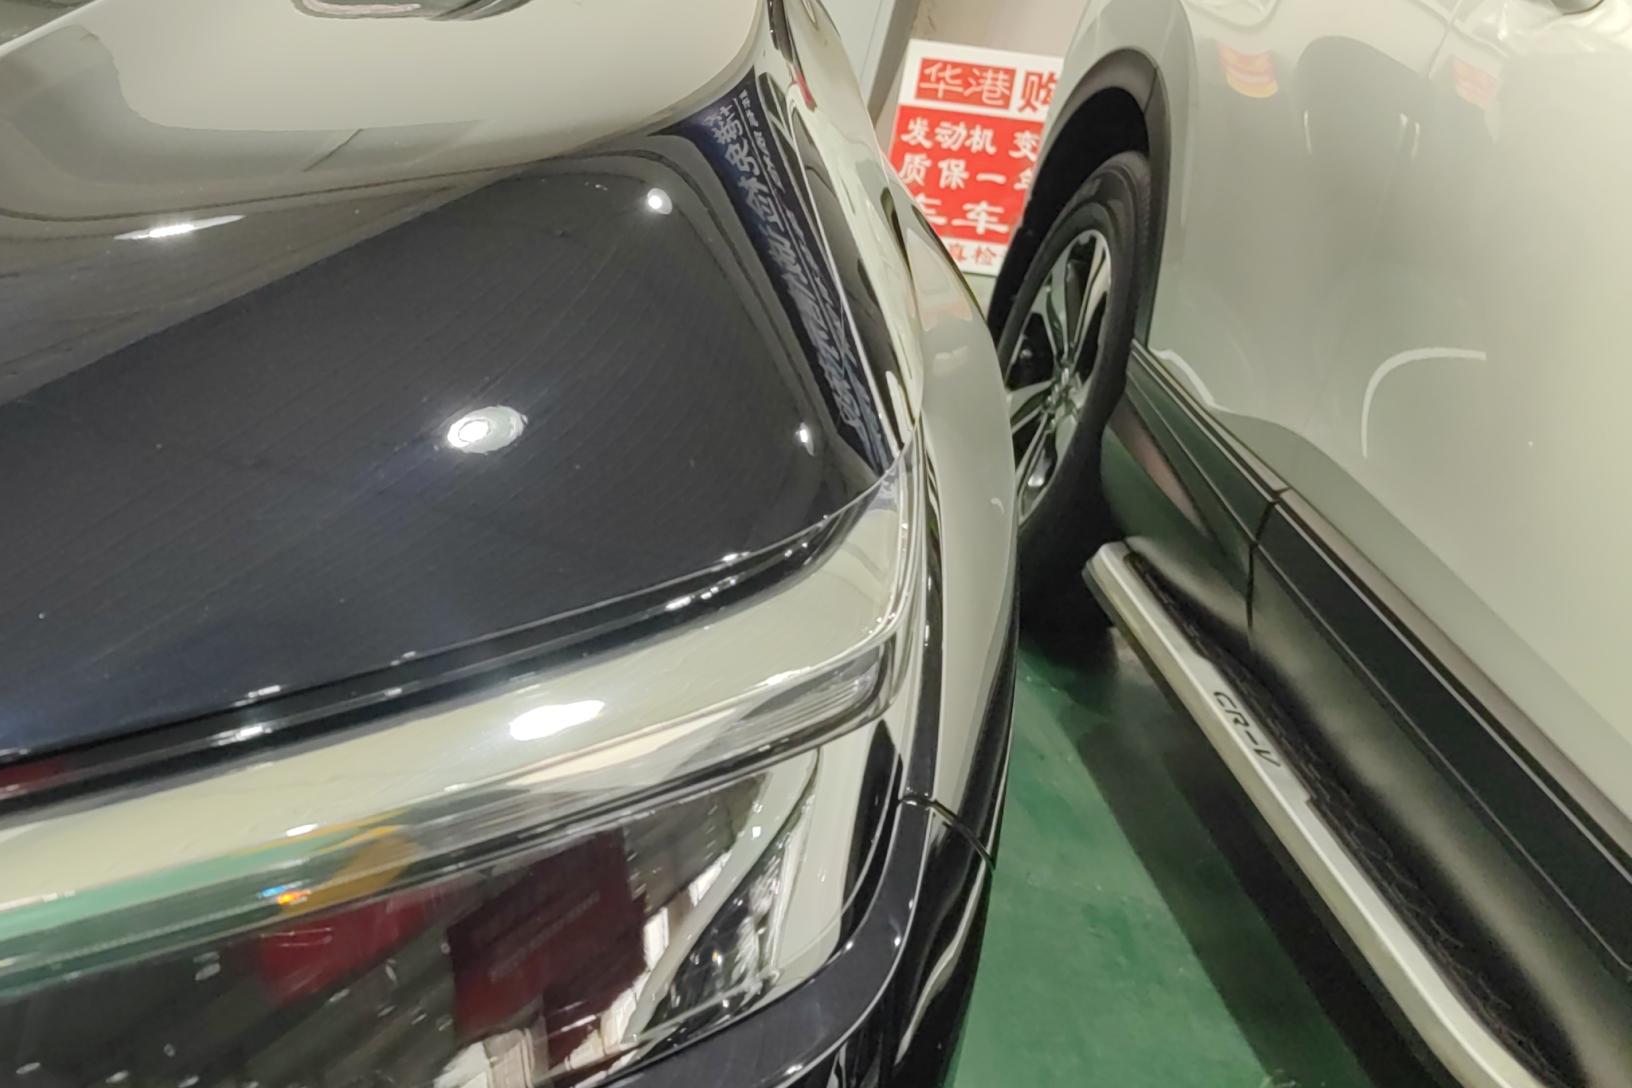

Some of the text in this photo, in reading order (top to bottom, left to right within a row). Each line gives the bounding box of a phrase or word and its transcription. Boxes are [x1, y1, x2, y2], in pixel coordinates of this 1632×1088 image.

[919, 61, 1011, 106] 华港
[900, 116, 997, 154] 发动机
[1213, 691, 1282, 768] CR-V
